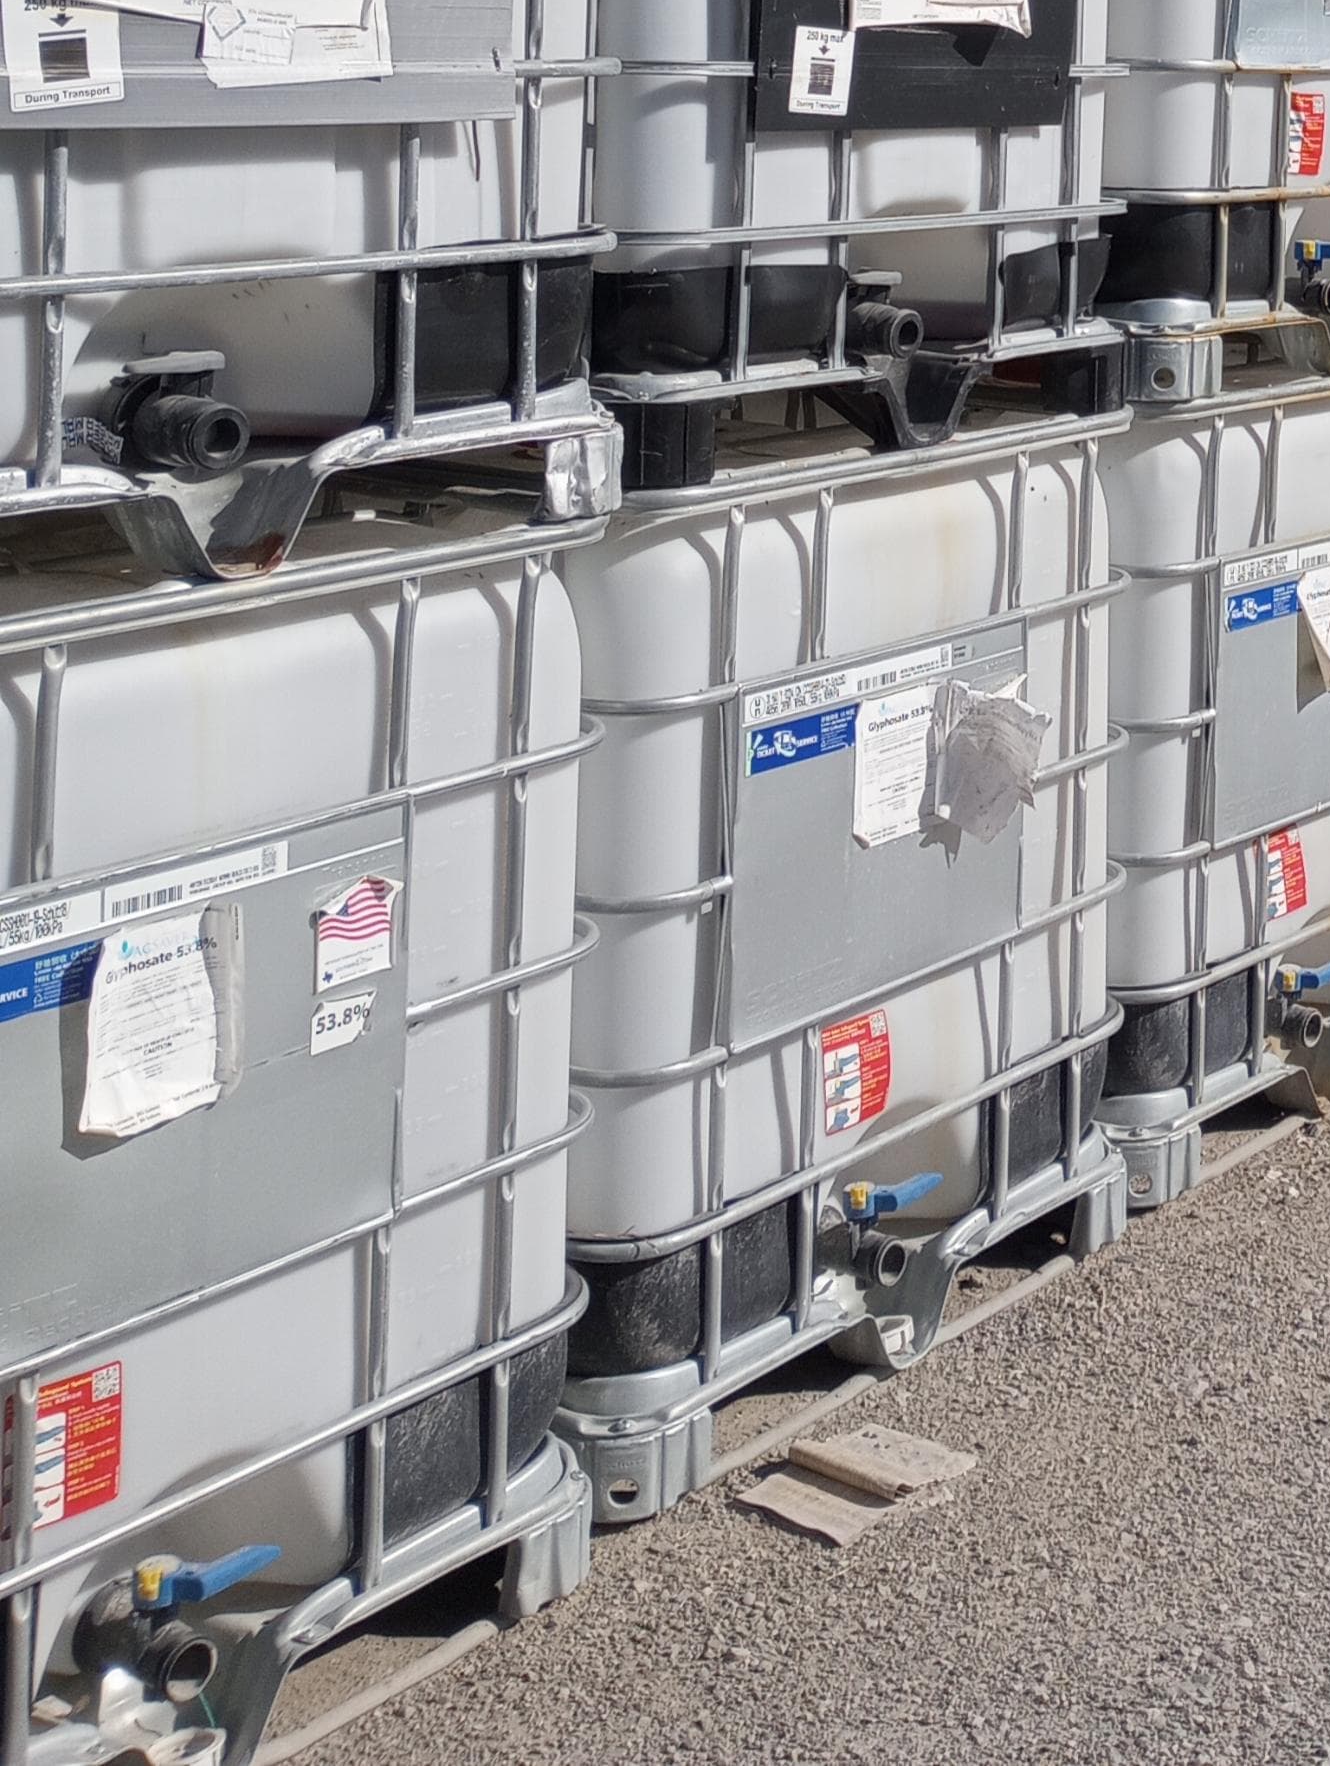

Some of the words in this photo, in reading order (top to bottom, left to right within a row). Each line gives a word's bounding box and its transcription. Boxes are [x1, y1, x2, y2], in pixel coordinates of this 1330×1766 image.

[806, 30, 820, 42] 250
[820, 30, 829, 44] kg
[24, 93, 60, 105] During
[62, 86, 111, 102] Transport
[867, 713, 910, 734] Glyphosate
[314, 1001, 371, 1036] 53.8%
[142, 1041, 173, 1056] CAUTION
